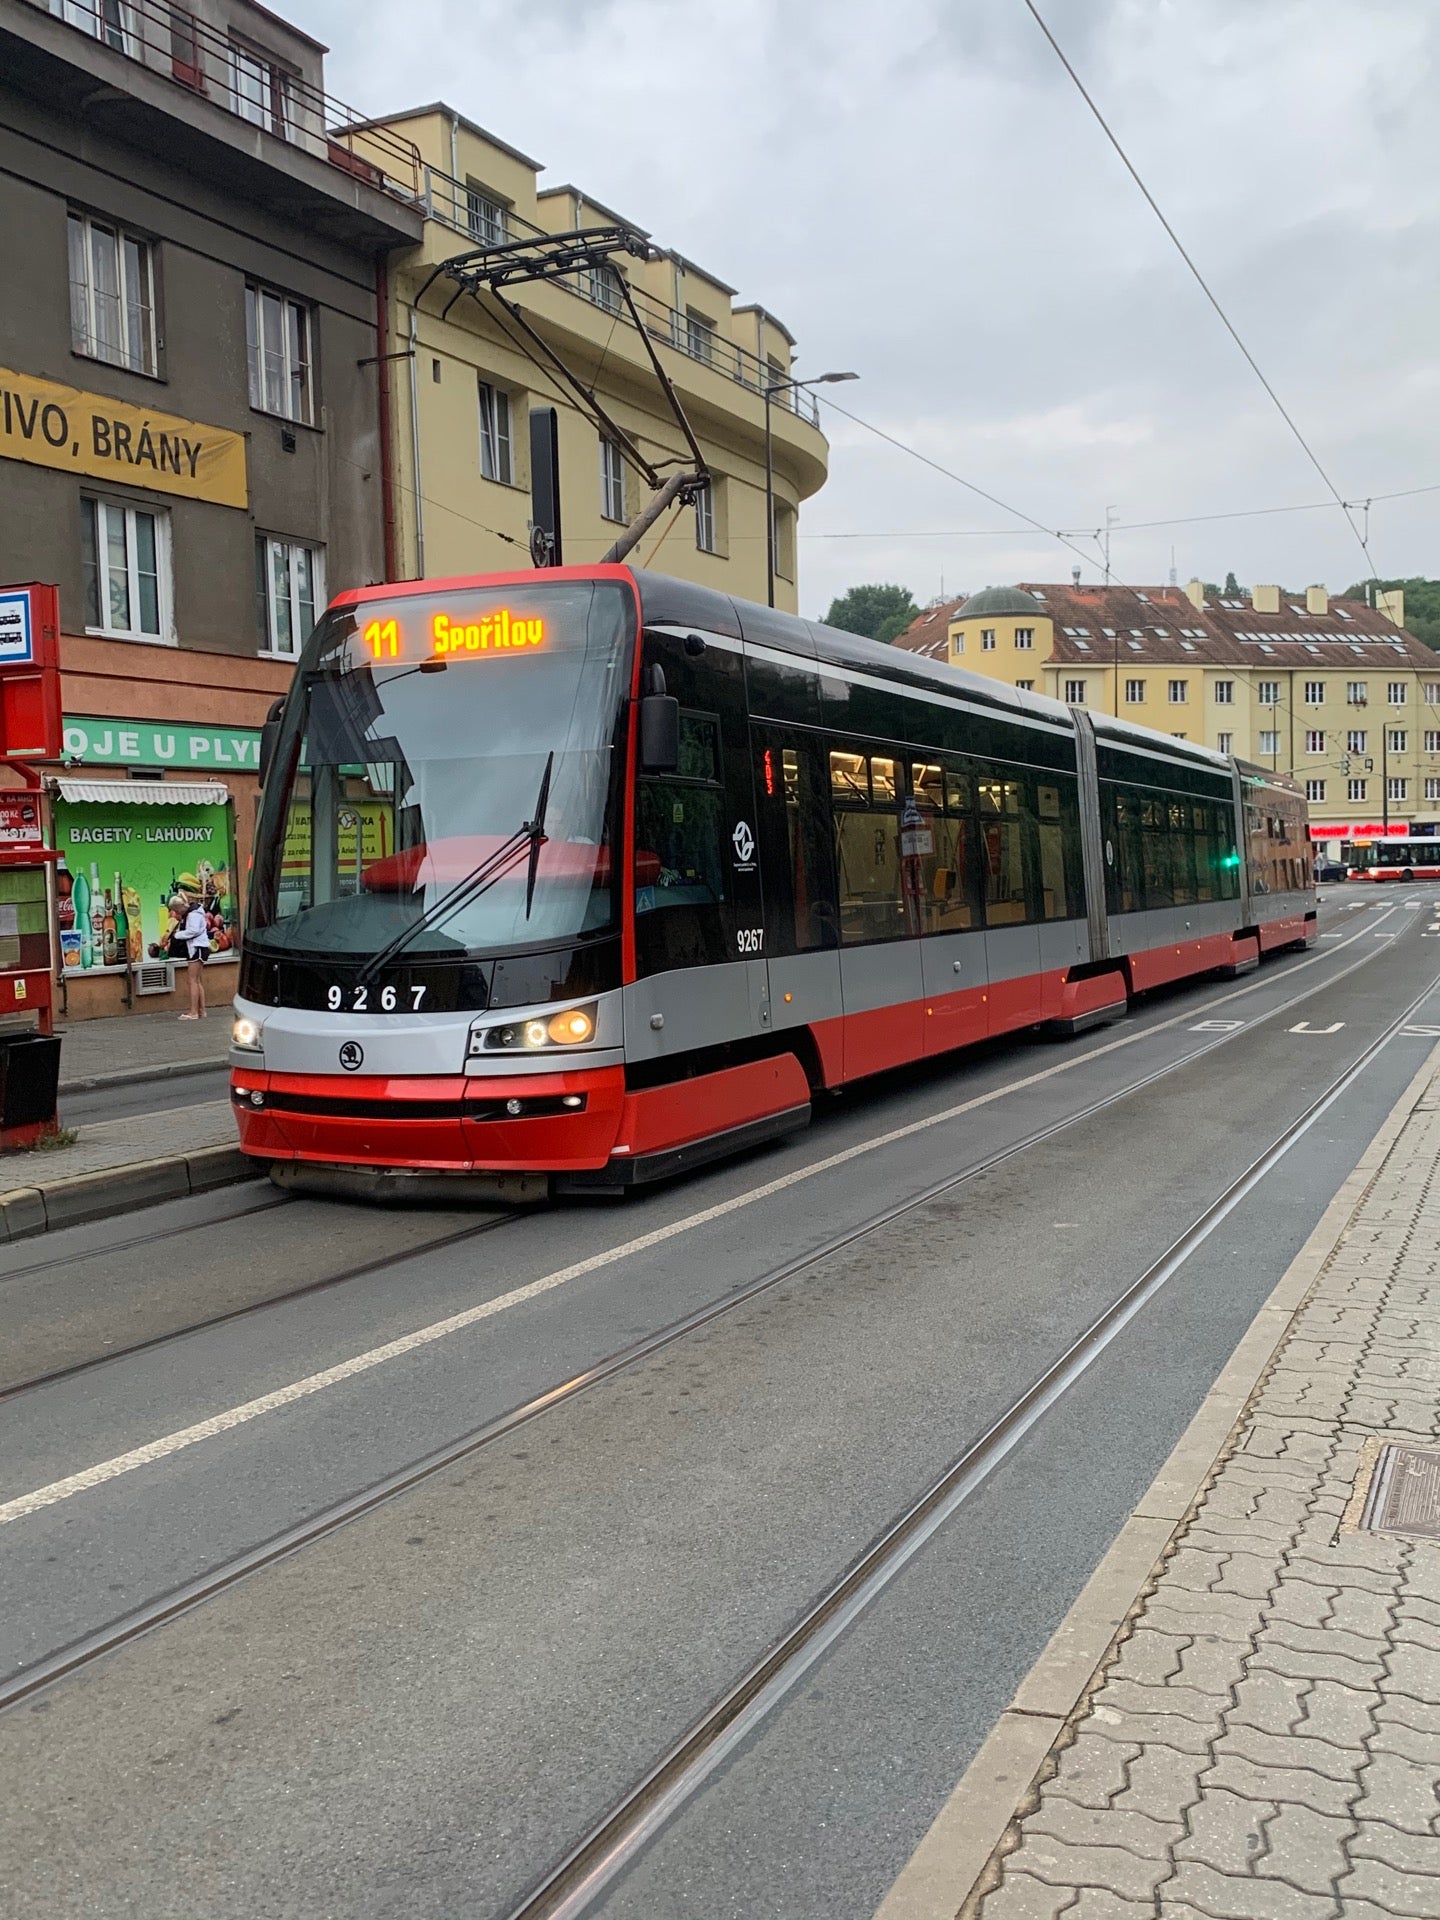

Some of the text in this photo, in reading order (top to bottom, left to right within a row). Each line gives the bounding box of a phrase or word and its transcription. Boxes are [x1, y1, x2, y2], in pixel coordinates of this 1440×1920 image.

[0, 390, 202, 478] IVO, BRÁNY
[364, 610, 543, 658] 11 Spořilov
[154, 734, 175, 759] U
[70, 828, 132, 843] BAGETY
[145, 823, 213, 842] LAHŮDKY
[736, 928, 764, 952] 9267
[327, 985, 427, 1010] 9267
